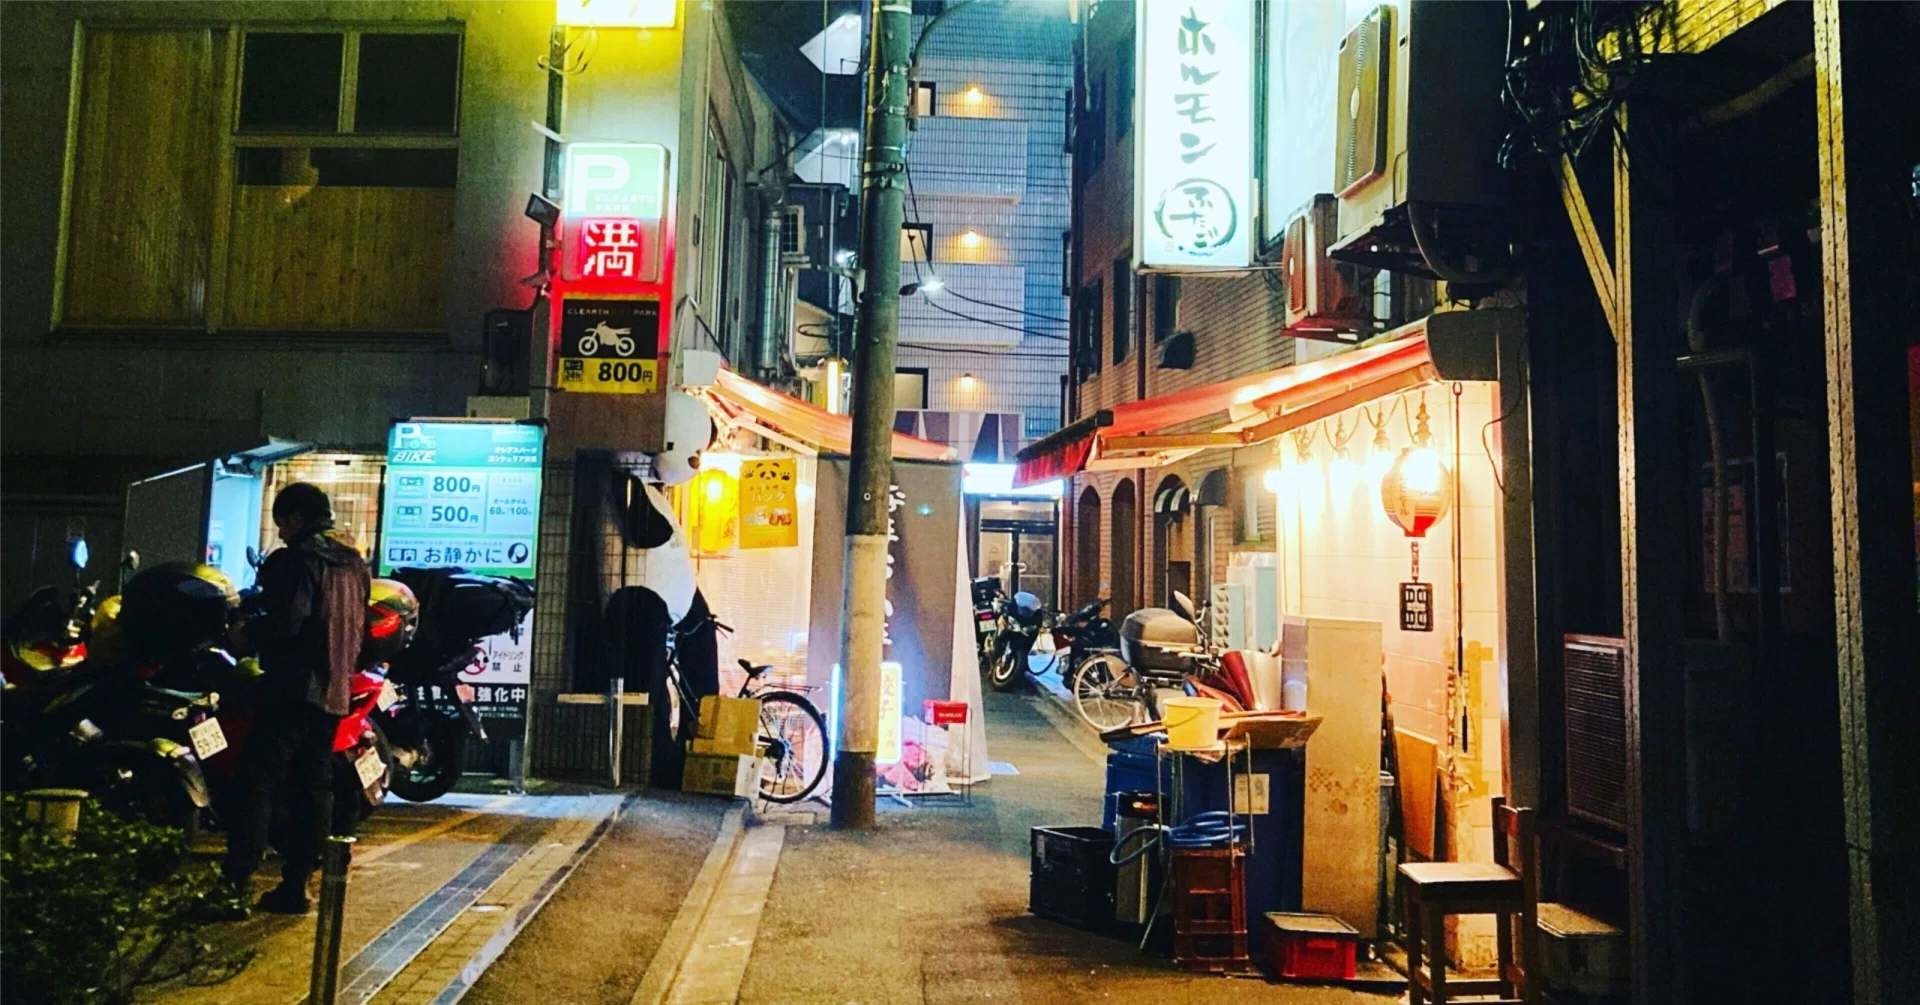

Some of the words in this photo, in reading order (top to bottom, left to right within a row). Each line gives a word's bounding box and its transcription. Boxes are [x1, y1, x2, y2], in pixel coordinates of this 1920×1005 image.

[1173, 5, 1221, 165] ホルモン
[571, 154, 631, 212] P
[1169, 186, 1218, 248] ふたご
[583, 222, 639, 276] 満
[598, 362, 653, 382] 800円
[392, 451, 435, 463] BIKE
[433, 476, 481, 493] 800円
[431, 505, 479, 523] 500円
[424, 547, 503, 564] お静かに
